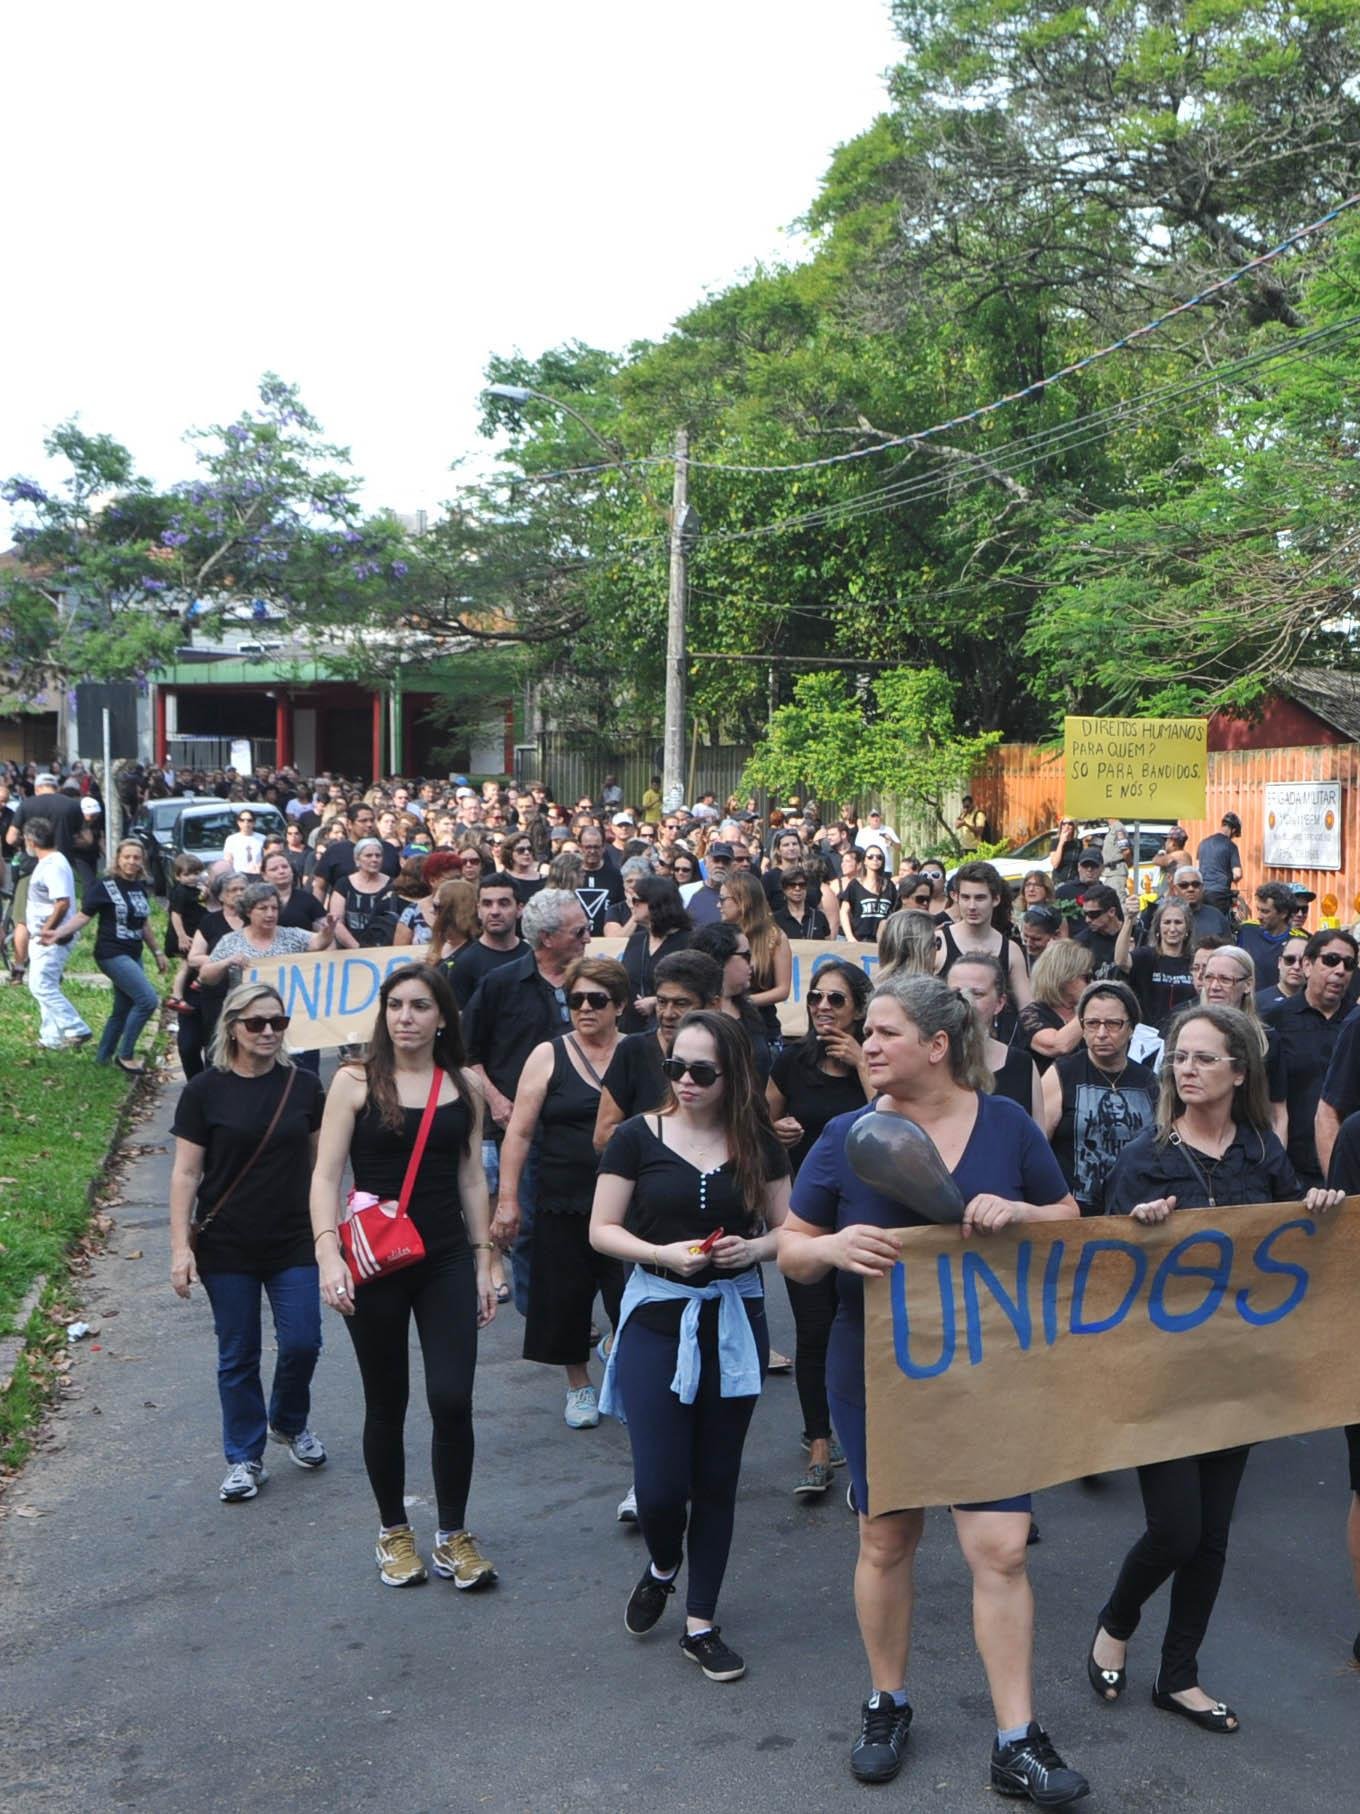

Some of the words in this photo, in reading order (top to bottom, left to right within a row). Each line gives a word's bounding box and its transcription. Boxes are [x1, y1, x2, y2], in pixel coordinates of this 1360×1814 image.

[1081, 719, 1137, 737] DIREITOS
[1142, 723, 1204, 742] HUMANOS
[1072, 741, 1104, 756] PARA
[1097, 762, 1134, 779] PARA
[1105, 784, 1113, 798] E
